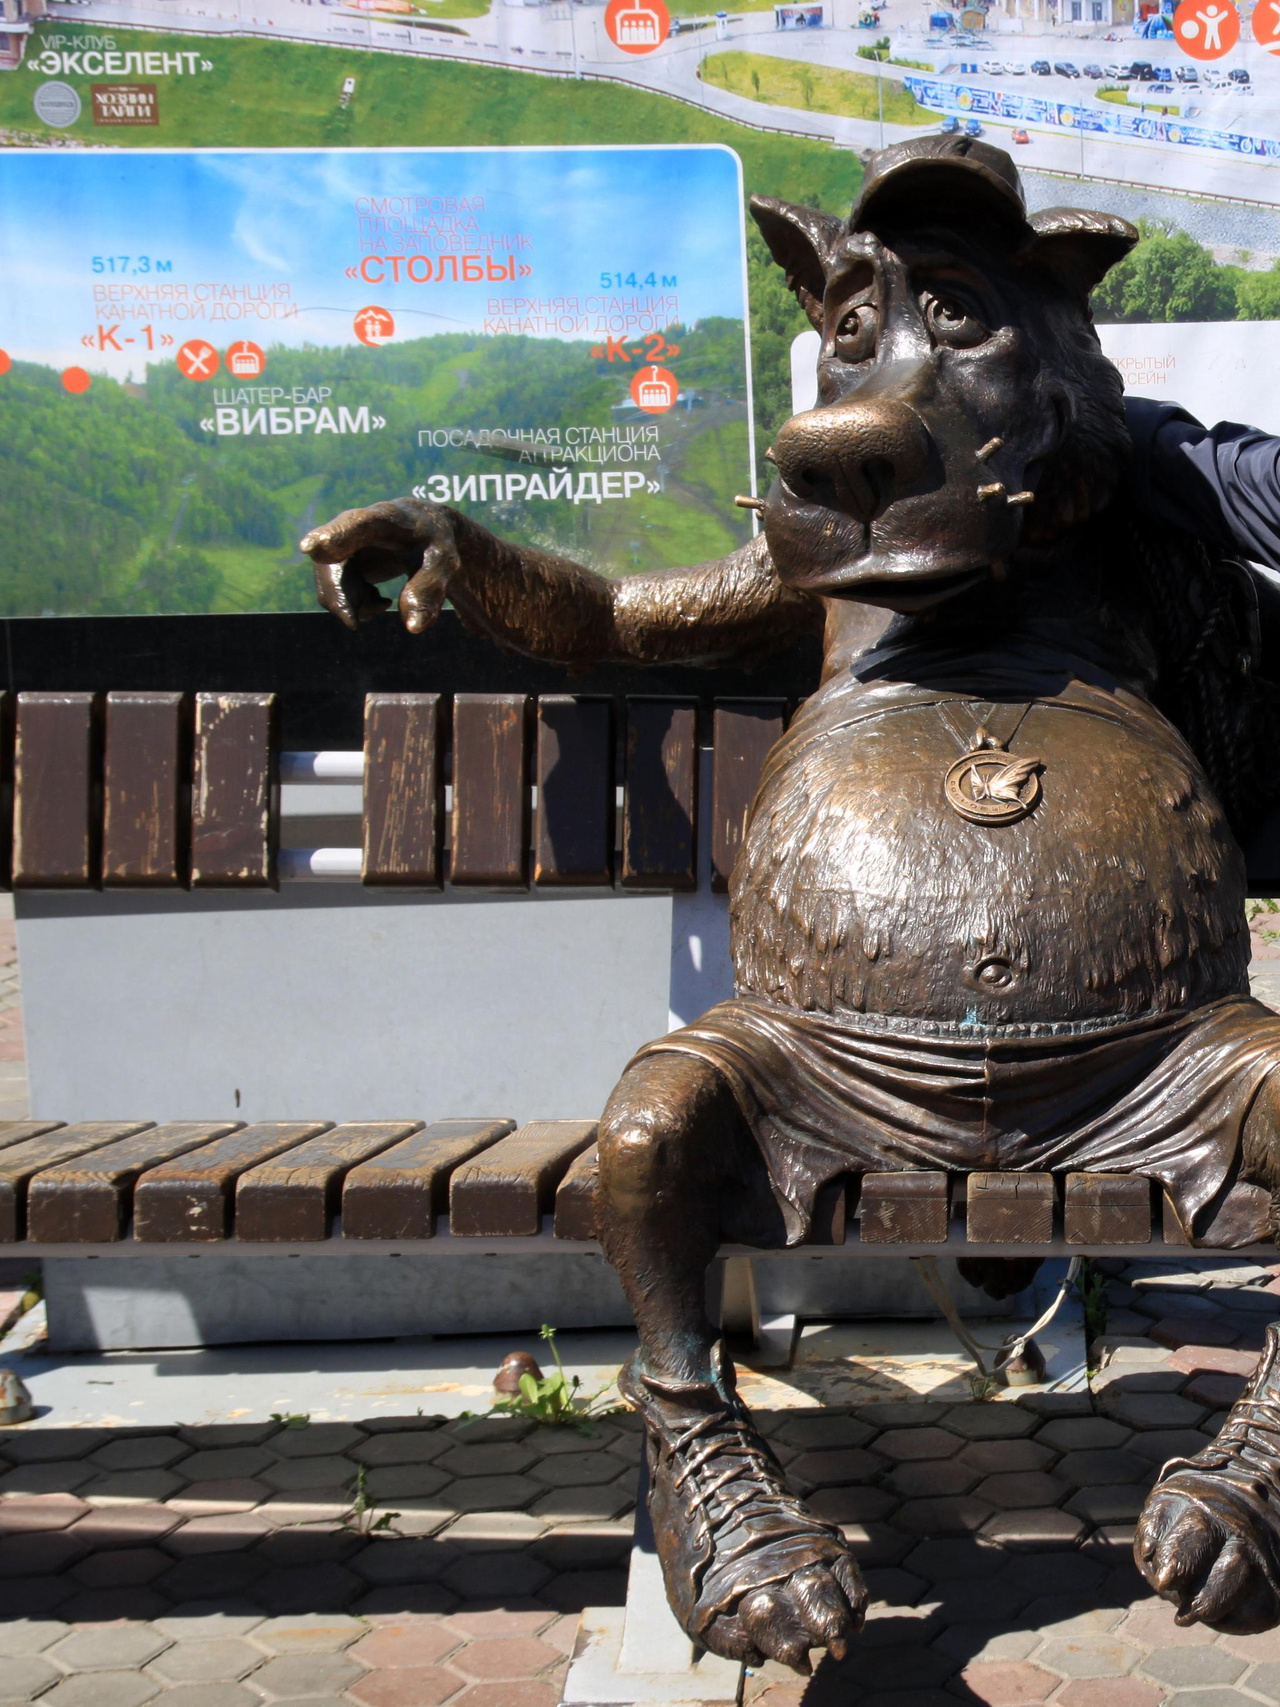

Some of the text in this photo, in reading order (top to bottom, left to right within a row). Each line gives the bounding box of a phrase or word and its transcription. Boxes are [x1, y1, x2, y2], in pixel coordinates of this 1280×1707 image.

[40, 35, 117, 50] VIP-КЛУБ
[27, 51, 214, 75] «ЭКСЕЛЕНТ»
[355, 197, 485, 214] СМОТРОВАЯ
[358, 216, 479, 234] ПЛОЩАДКА
[360, 234, 535, 253] НА ЗАПОВЕДНИК
[91, 256, 173, 275] 517,3 м
[344, 254, 532, 283] «СТОЛБЫ»
[600, 272, 678, 290] 514,4 м
[92, 283, 290, 302] ВЕРХНЯЯ СТАНЦИЯ
[95, 301, 298, 321] КАНАТНОЙ ДОРОГИ
[487, 295, 679, 316] ВЕРХНЯЯ СТАНЦИЯ
[483, 314, 680, 334] КАНАТНОЙ ДОРОГИ
[81, 324, 174, 351] «К-1»
[590, 334, 681, 362] «К-2»
[213, 387, 332, 405] ШАТЕР-БАР
[200, 406, 387, 435] «ВИБРАМ»
[418, 426, 659, 448] ПОСАДОЧНАЯ СТАНЦИЯ
[412, 467, 660, 504] «ЗИПРАЙДЕР»
